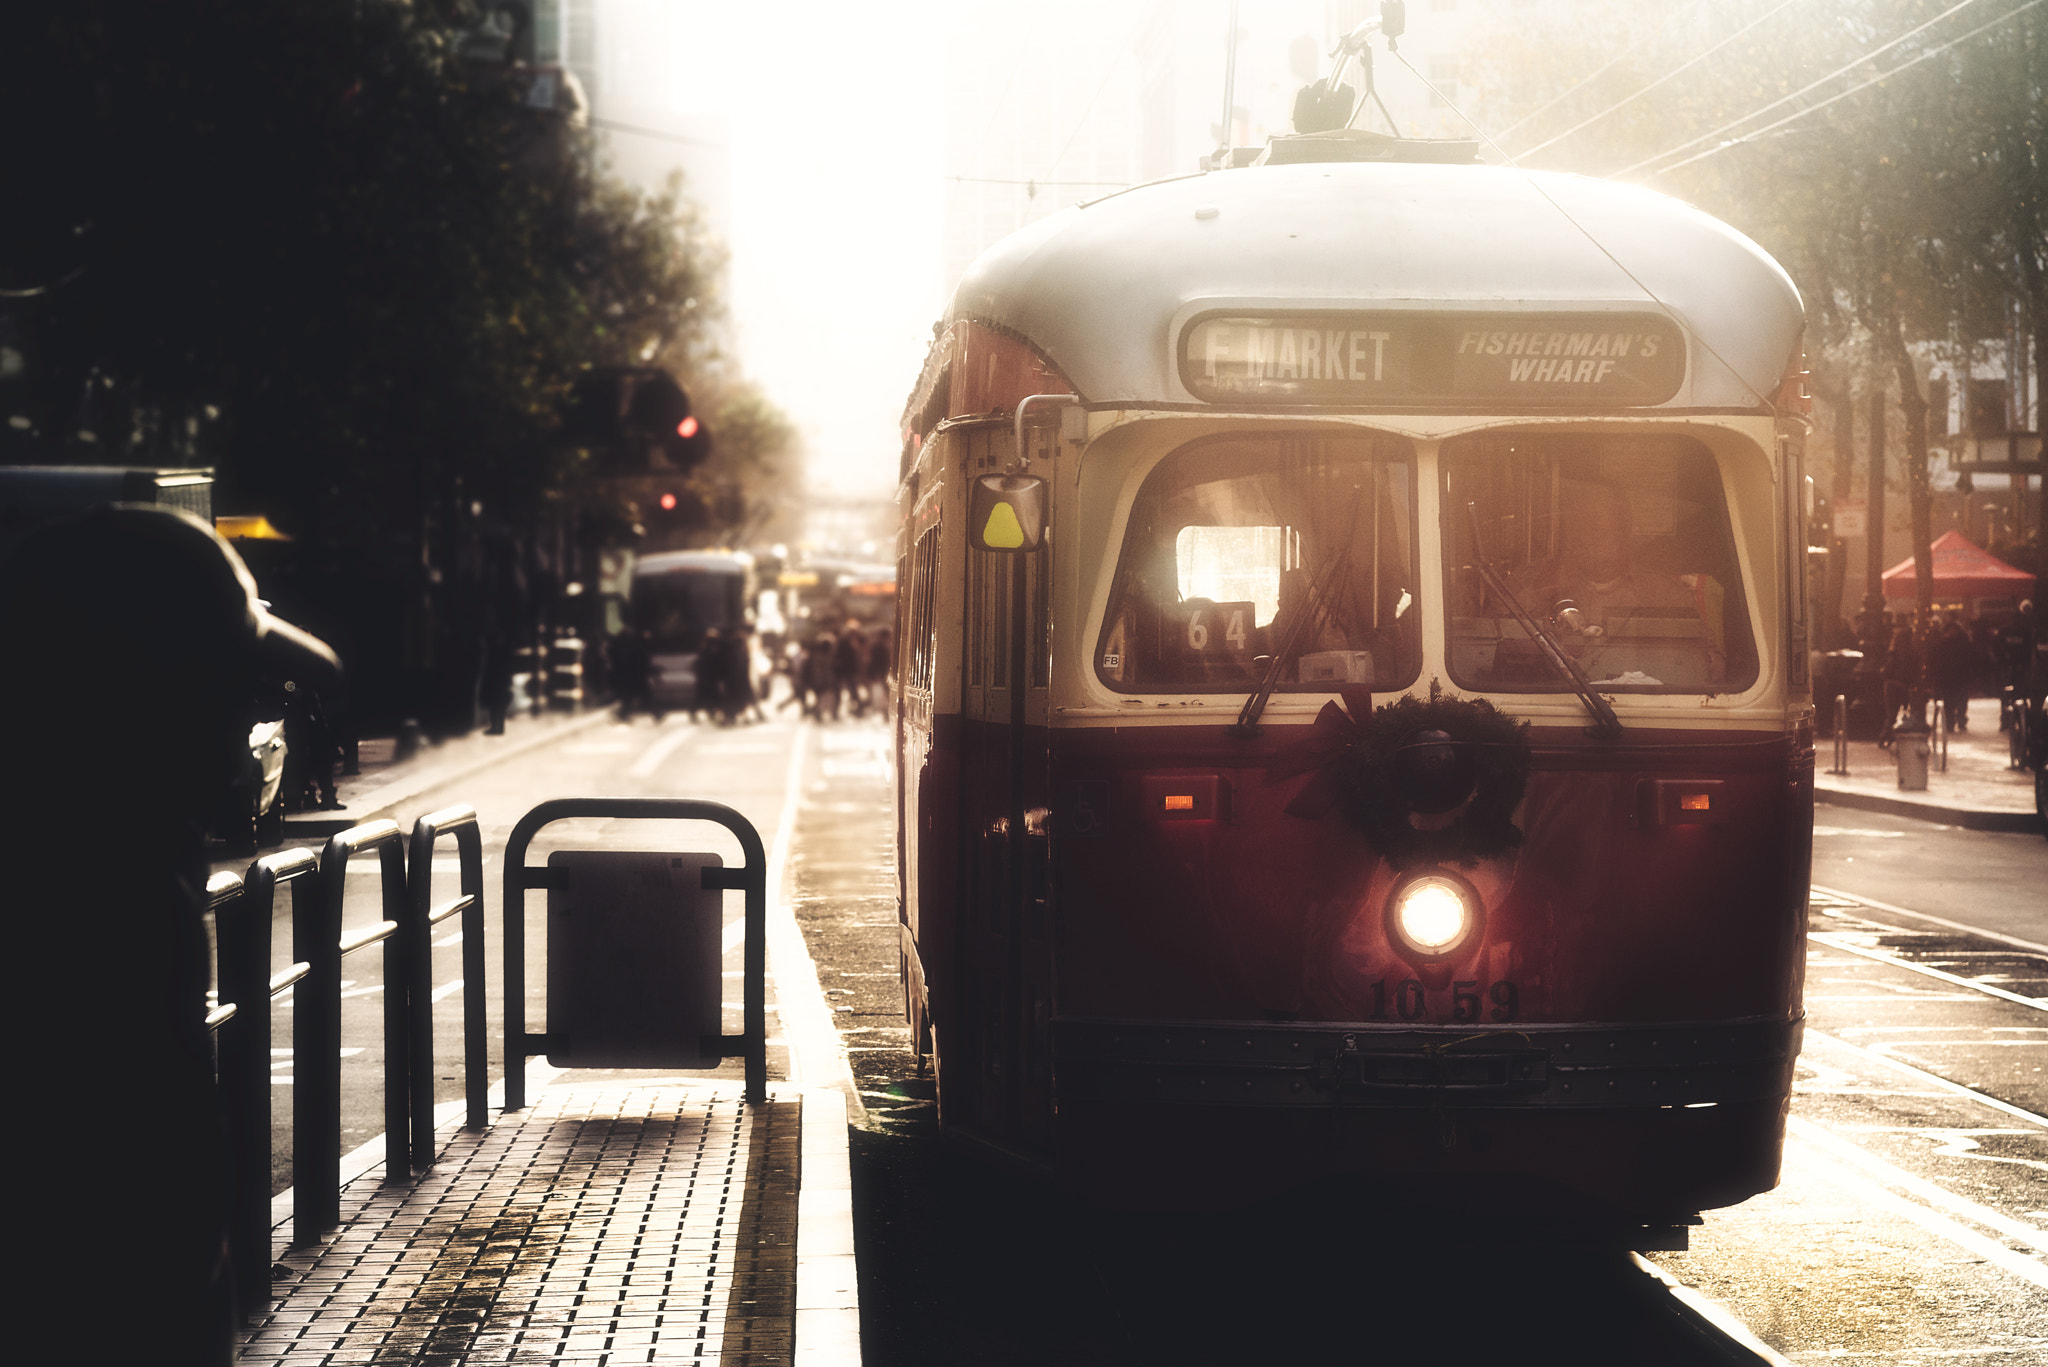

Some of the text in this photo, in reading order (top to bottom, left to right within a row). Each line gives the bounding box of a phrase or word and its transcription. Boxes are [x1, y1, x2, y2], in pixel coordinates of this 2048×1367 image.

[1205, 327, 1391, 381] F MARKET
[1456, 331, 1663, 358] FISHERMAN'S
[1509, 358, 1616, 383] WHARF
[1104, 656, 1119, 666] FB
